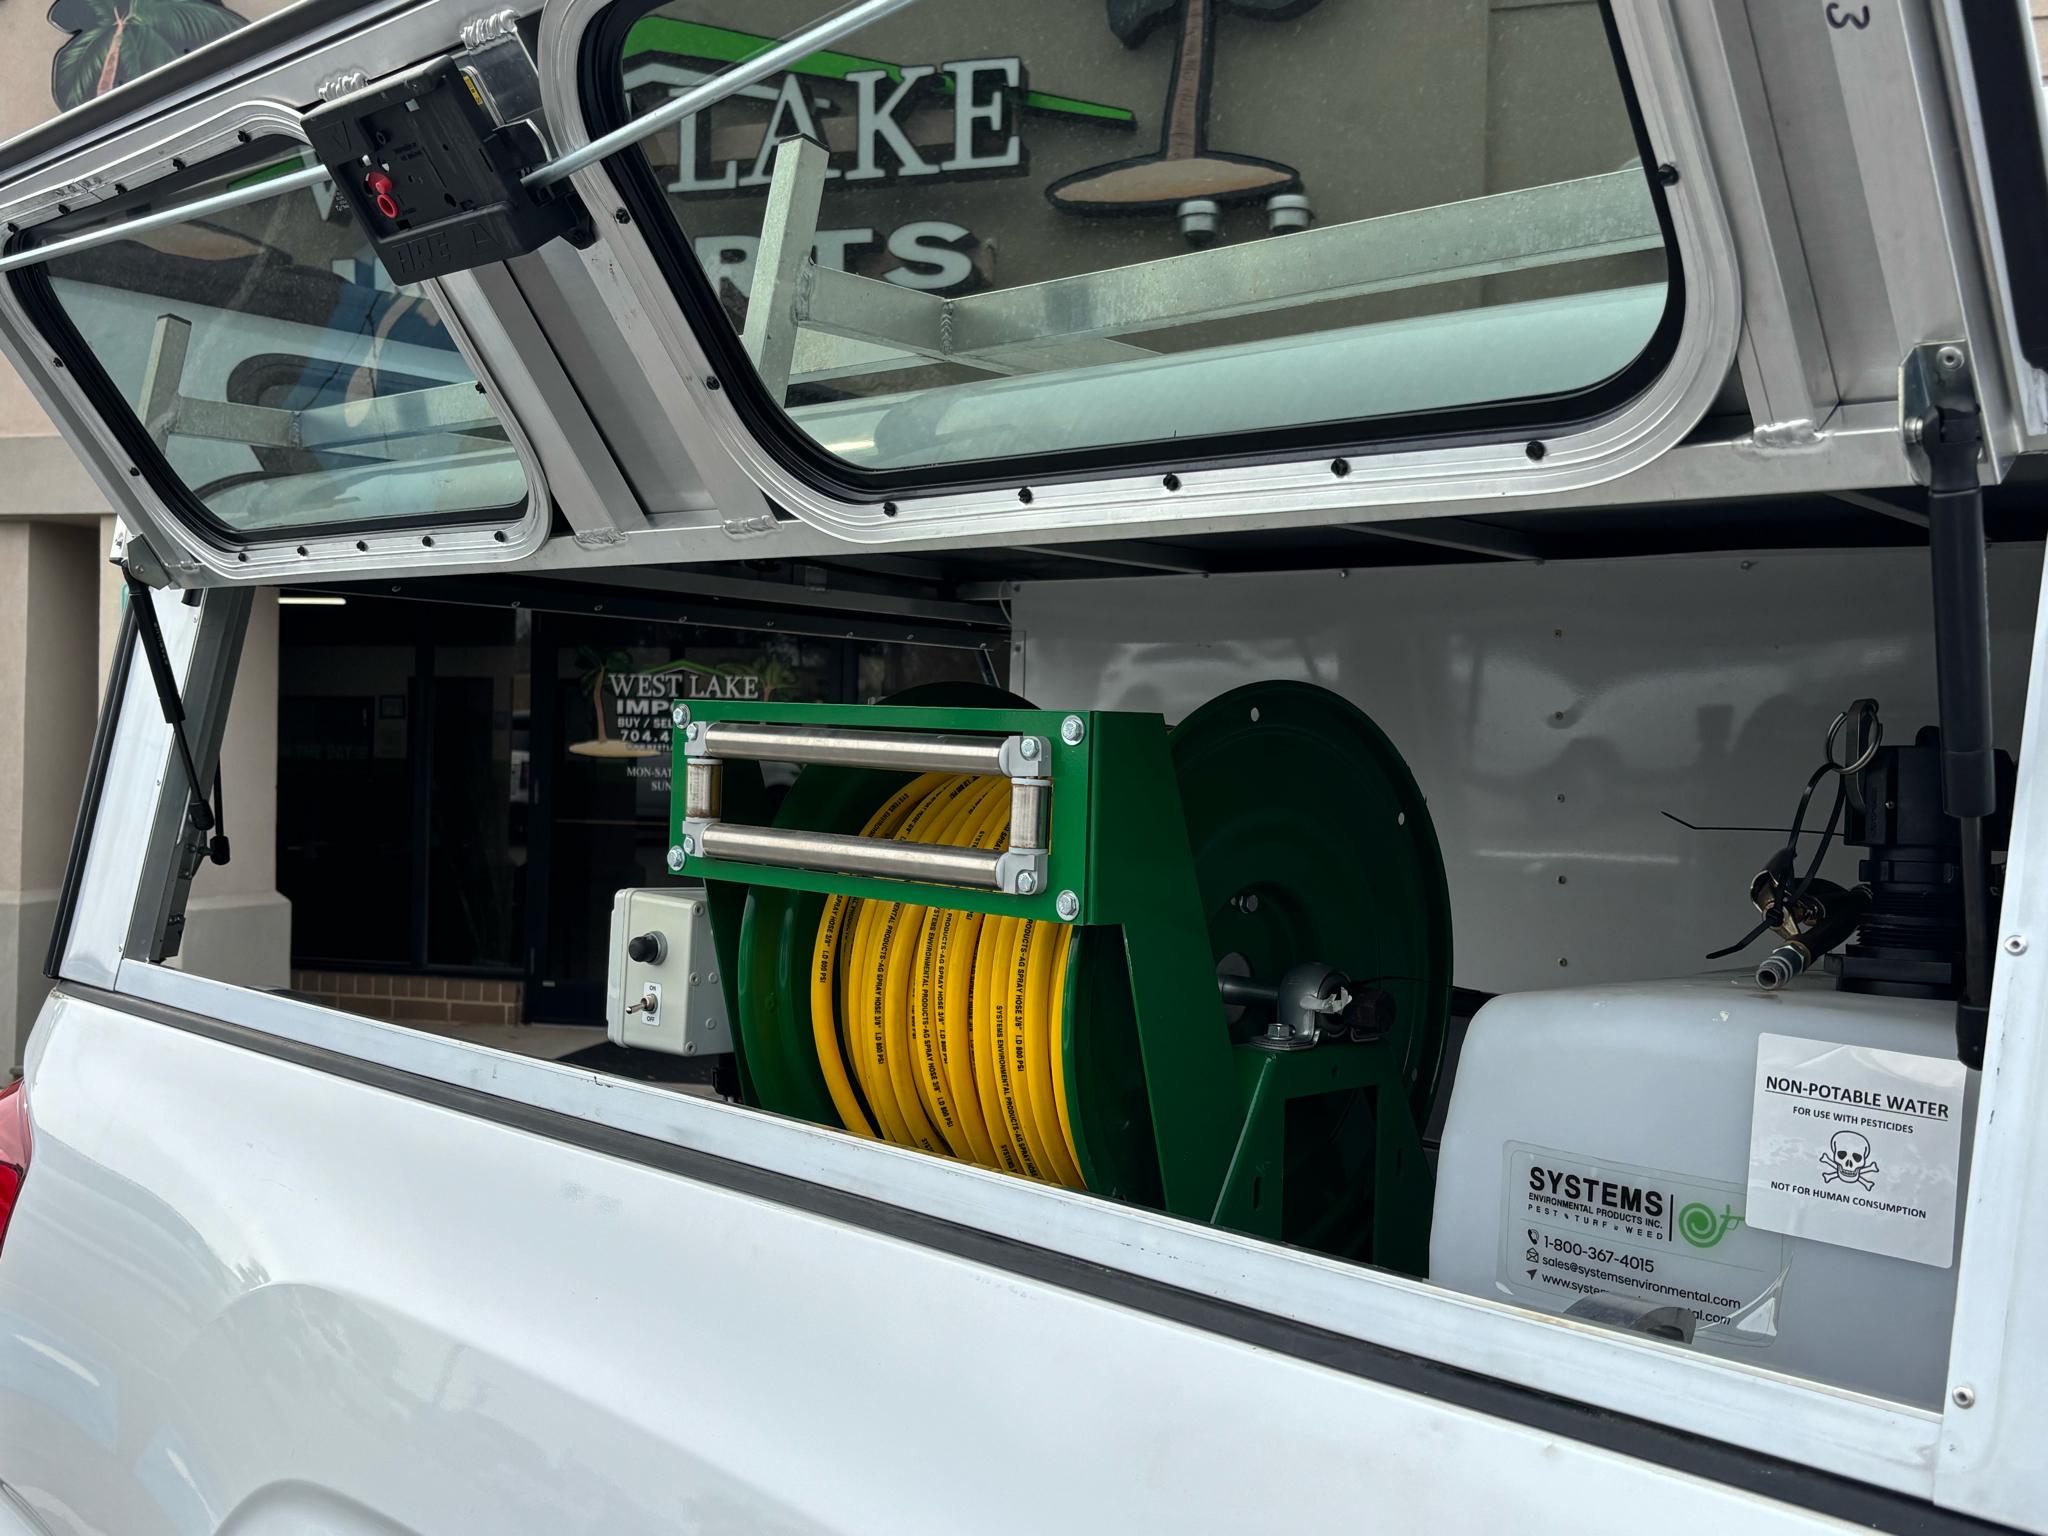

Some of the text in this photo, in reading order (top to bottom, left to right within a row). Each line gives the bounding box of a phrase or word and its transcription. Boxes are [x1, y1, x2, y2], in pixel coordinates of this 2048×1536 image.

[668, 57, 1021, 193] LAKE
[608, 673, 759, 699] WEST LAKE
[616, 699, 674, 714] IMP
[617, 718, 641, 728] BUY
[1015, 968, 1025, 993] SPRAY
[1015, 994, 1023, 1015] HOSE
[996, 1005, 1004, 1038] SYSTEMS
[1015, 1046, 1024, 1059] 800
[1017, 1060, 1025, 1072] PSI
[928, 1062, 938, 1081] HOSE
[1766, 1076, 1949, 1119] NON-POTABLE WATER
[1793, 1106, 1914, 1134] FOR USE WITH PESTICIDES
[1529, 1167, 1663, 1217] SYSTEMS
[1771, 1181, 1927, 1219] NOT FOR HUMAN CONSUMPTION
[1528, 1193, 1663, 1229] ENVIRONMENTAL PRODUCTS INC.
[1528, 1204, 1663, 1240] PEST TURF WEED
[1544, 1236, 1655, 1273] 1-800-367-4015
[1542, 1255, 1742, 1310] sales@systemsenvironmental.com
